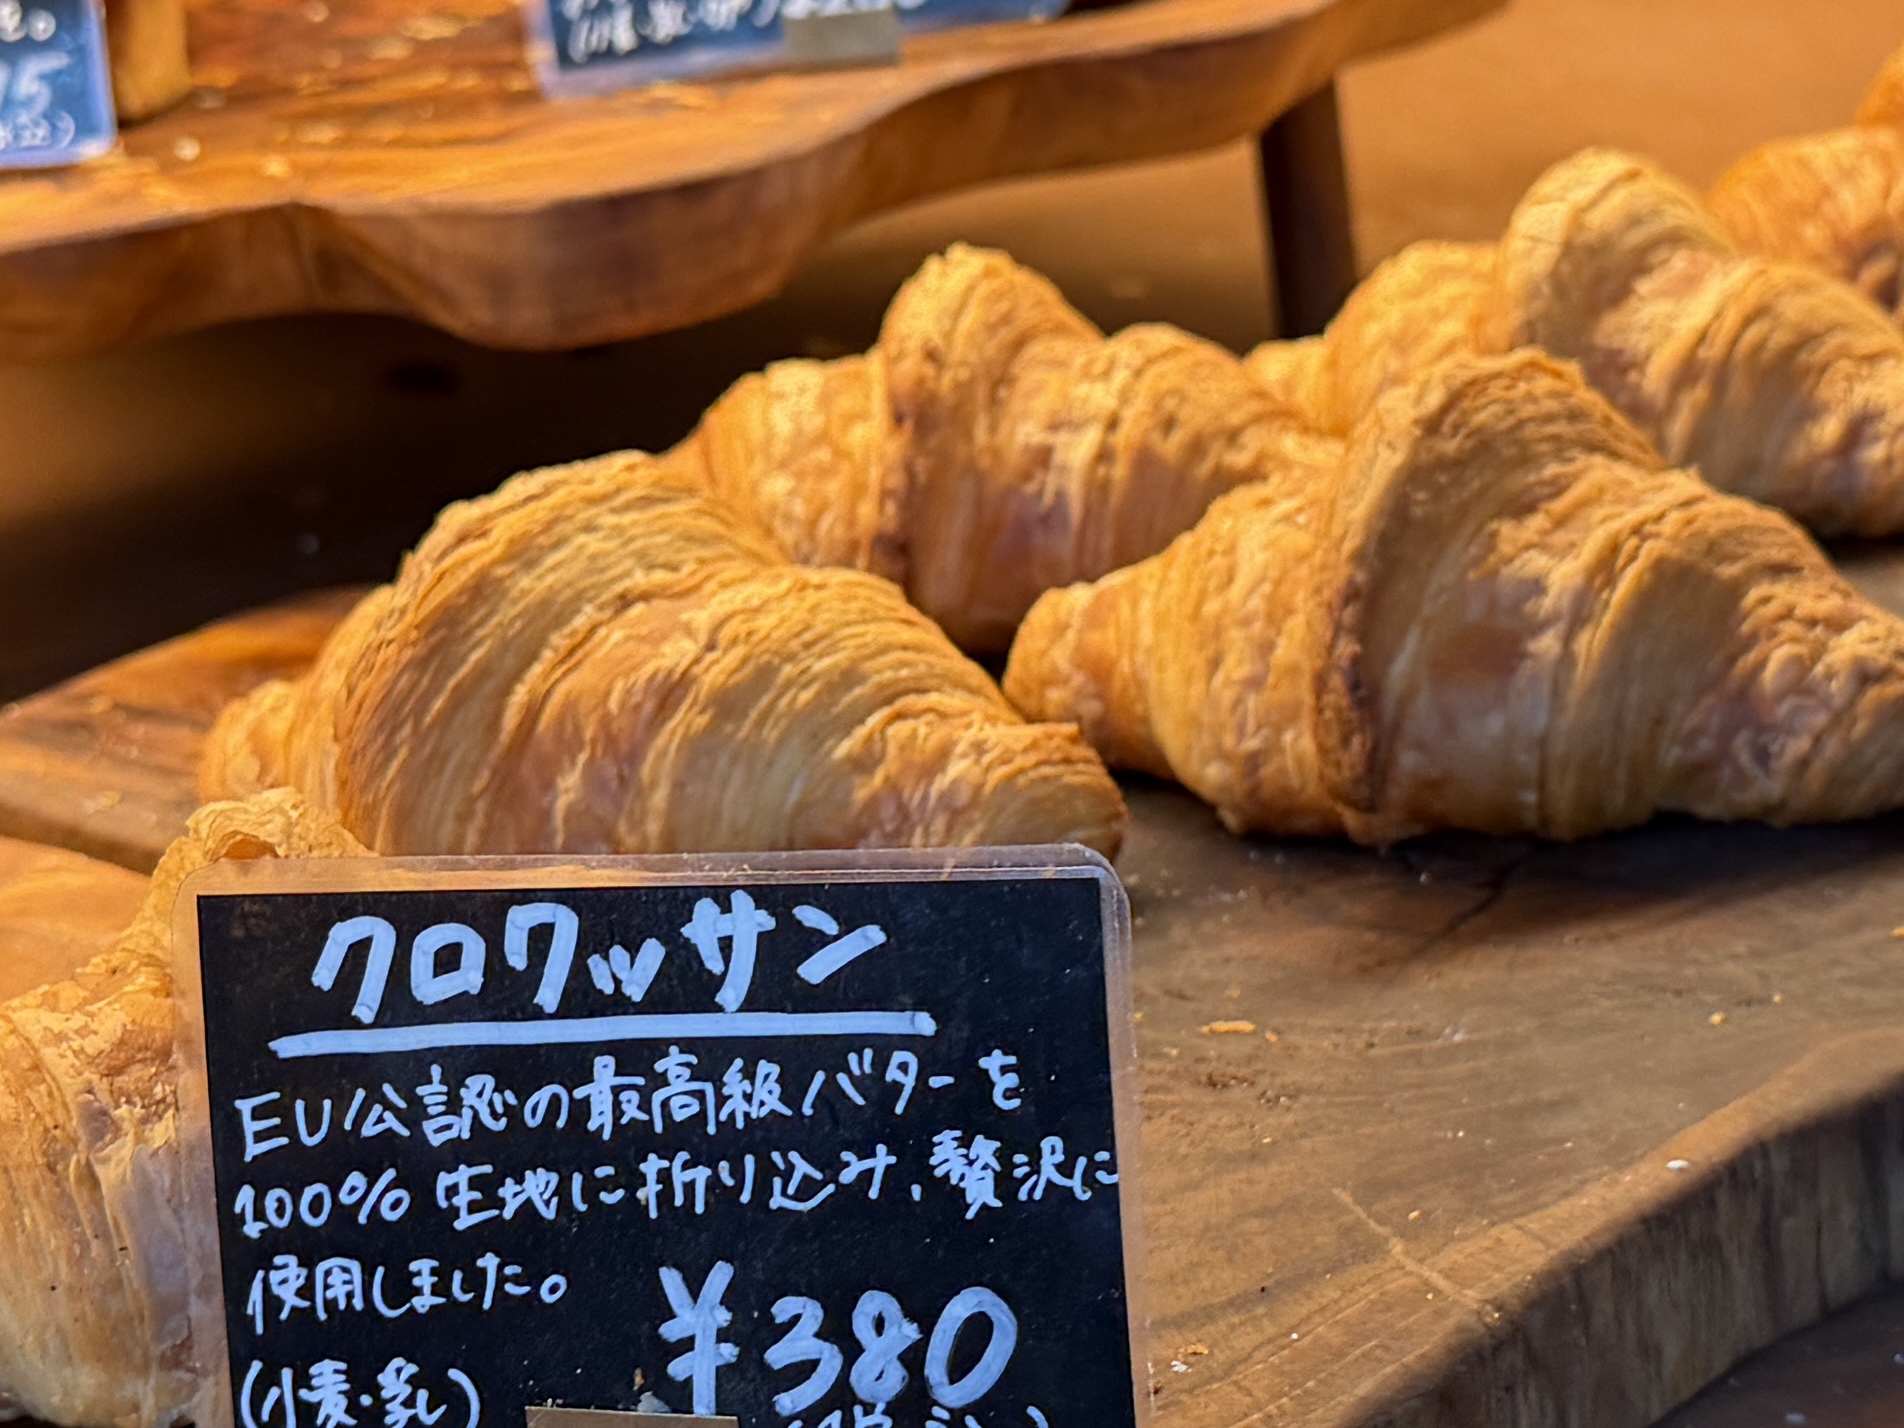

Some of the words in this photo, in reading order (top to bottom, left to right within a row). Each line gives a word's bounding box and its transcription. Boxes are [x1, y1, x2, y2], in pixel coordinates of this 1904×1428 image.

[310, 890, 887, 1024] クロワッサン
[233, 1046, 1024, 1161] EU公認の最高級バターを
[244, 1252, 569, 1336] 使用しました。
[659, 1259, 1018, 1418] ¥380
